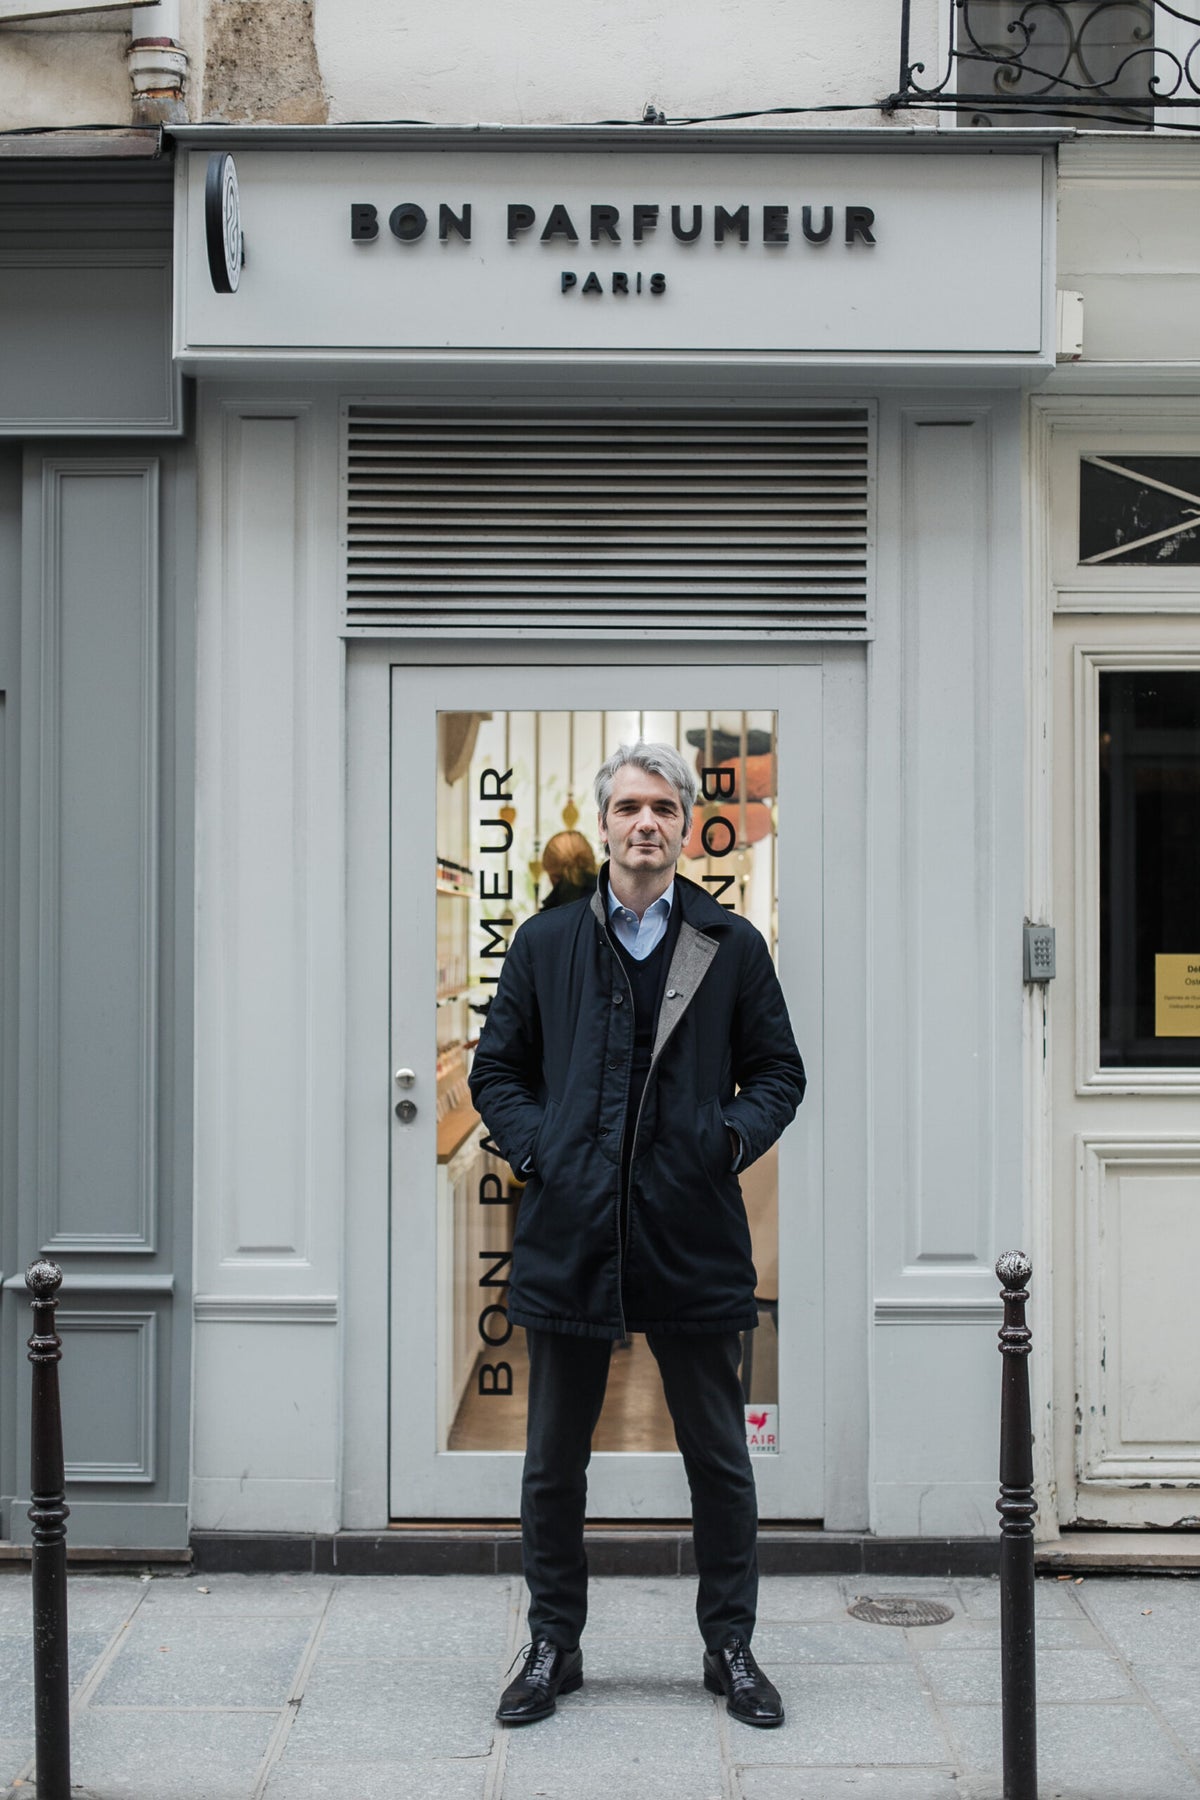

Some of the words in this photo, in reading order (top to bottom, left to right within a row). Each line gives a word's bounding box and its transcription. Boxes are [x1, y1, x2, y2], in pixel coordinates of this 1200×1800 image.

[351, 203, 471, 241] BON
[507, 204, 877, 244] PARFUMEUR
[561, 271, 666, 295] PARIS
[701, 767, 736, 910] BON
[479, 767, 514, 1205] PAMEUR
[479, 1251, 514, 1396] BON
[746, 1434, 776, 1445] AIR
